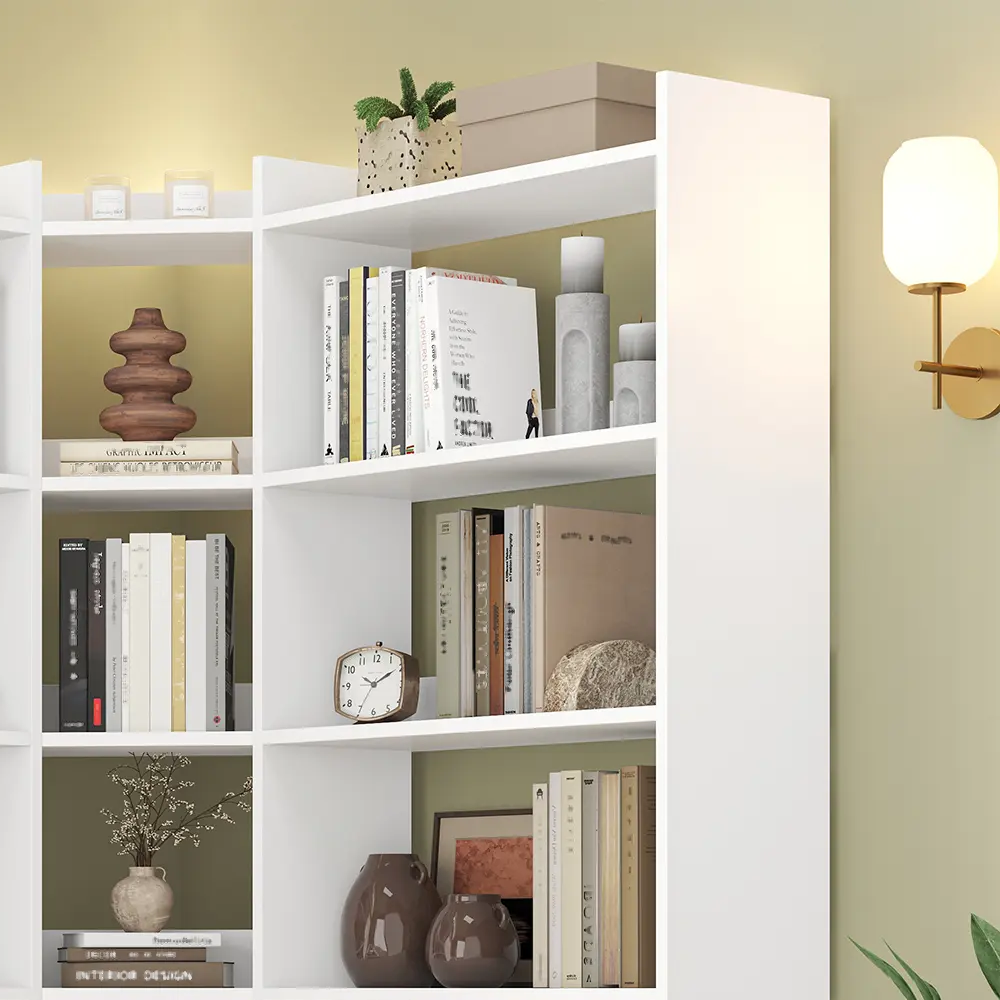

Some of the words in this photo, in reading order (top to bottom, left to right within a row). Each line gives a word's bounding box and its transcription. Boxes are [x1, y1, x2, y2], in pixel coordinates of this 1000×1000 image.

[421, 364, 431, 410] DELIGHTS
[359, 657, 366, 666] 11
[373, 654, 381, 663] 12
[389, 656, 393, 664] 1
[347, 666, 356, 674] 10
[345, 682, 351, 690] 9
[347, 699, 353, 708] 8
[371, 707, 377, 716] 6
[386, 704, 391, 713] 5
[75, 970, 137, 981] INTERIOR
[144, 970, 193, 981] DESIGN
